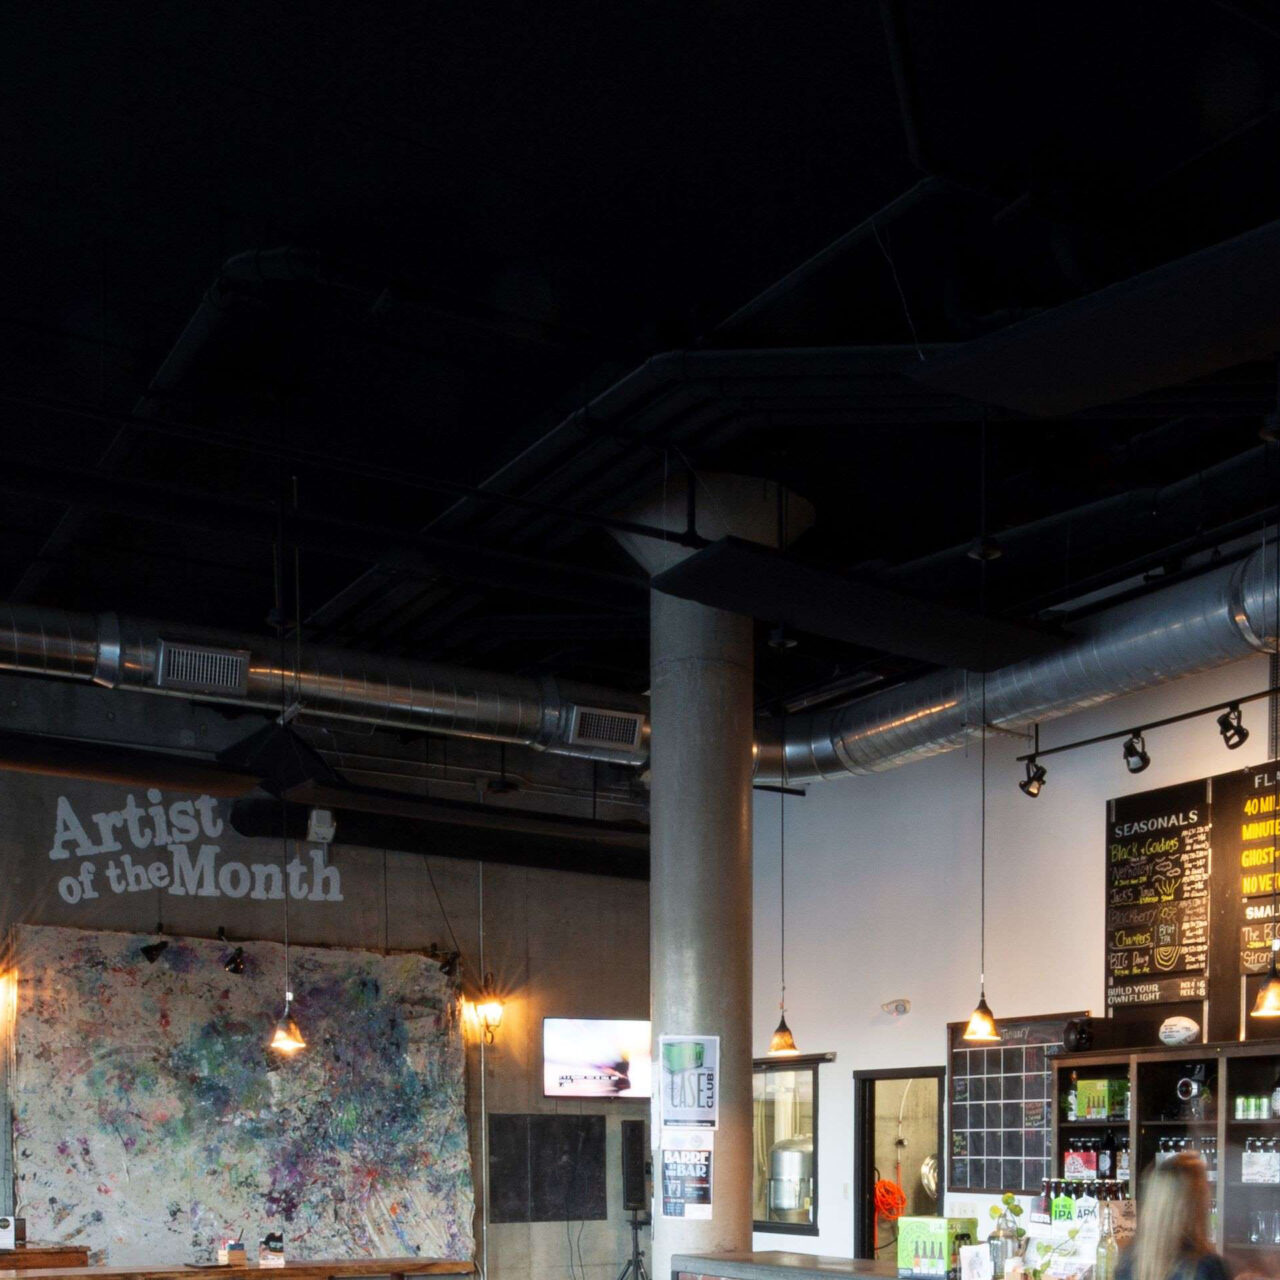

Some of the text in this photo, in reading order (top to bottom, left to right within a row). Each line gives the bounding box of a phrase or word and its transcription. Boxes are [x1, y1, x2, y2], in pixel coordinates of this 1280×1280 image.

[1244, 798, 1259, 816] 40
[49, 788, 224, 860] Artist
[1115, 810, 1198, 838] SEASONALS
[1241, 847, 1275, 868] GHOST
[58, 844, 344, 904] of the Month
[1242, 876, 1258, 894] NO
[1108, 983, 1159, 996] BUILD YOUR
[1108, 991, 1160, 1005] OWN FLIGHT
[670, 1072, 706, 1109] CASE
[706, 1072, 714, 1109] CLUB
[664, 1151, 709, 1165] BARRE
[677, 1164, 707, 1178] BAR
[1055, 1209, 1073, 1220] IPA
